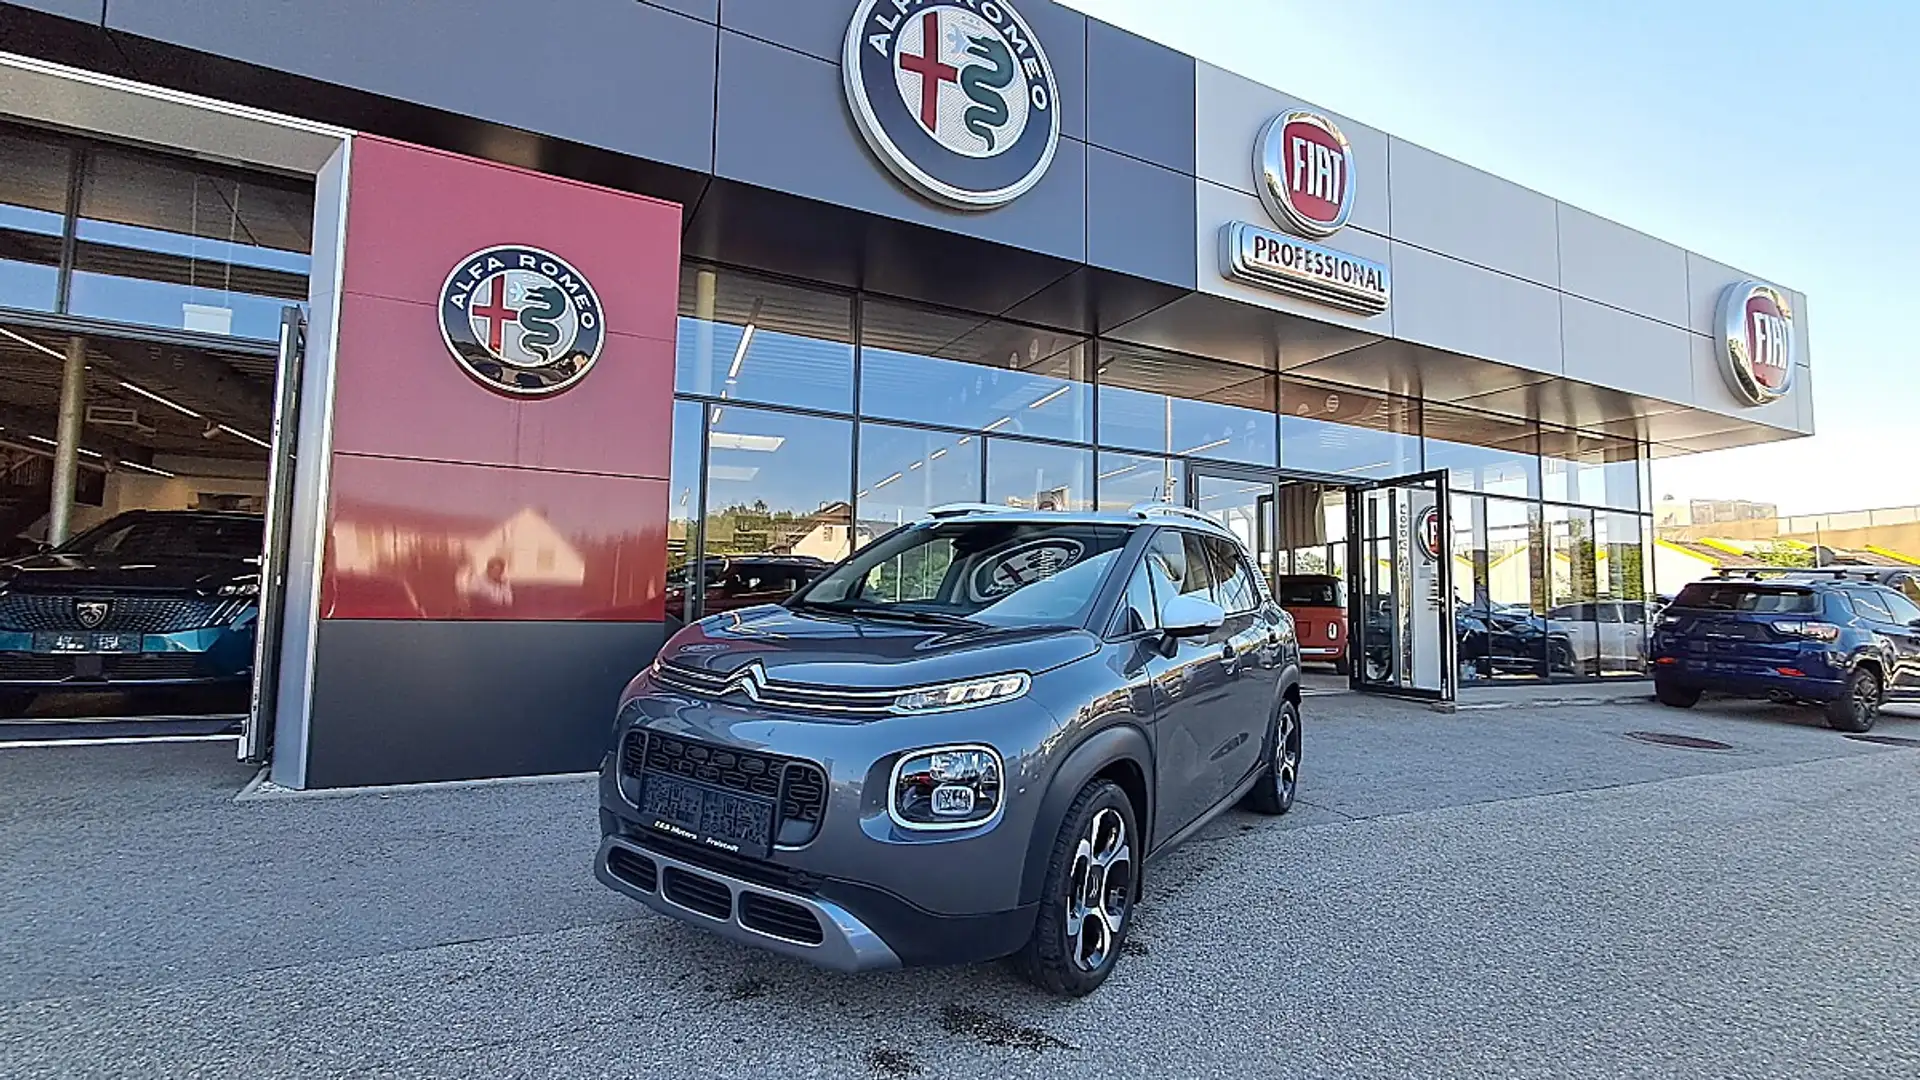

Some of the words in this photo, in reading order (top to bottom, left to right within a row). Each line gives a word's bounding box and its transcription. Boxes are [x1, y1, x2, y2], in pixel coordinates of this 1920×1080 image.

[868, 0, 924, 58] ALF
[955, 0, 1047, 110] OMEO
[1292, 136, 1344, 205] FIAT
[450, 257, 505, 310] ALFA
[518, 254, 595, 329] ROMEO
[1253, 235, 1386, 293] PROFESSIONAL
